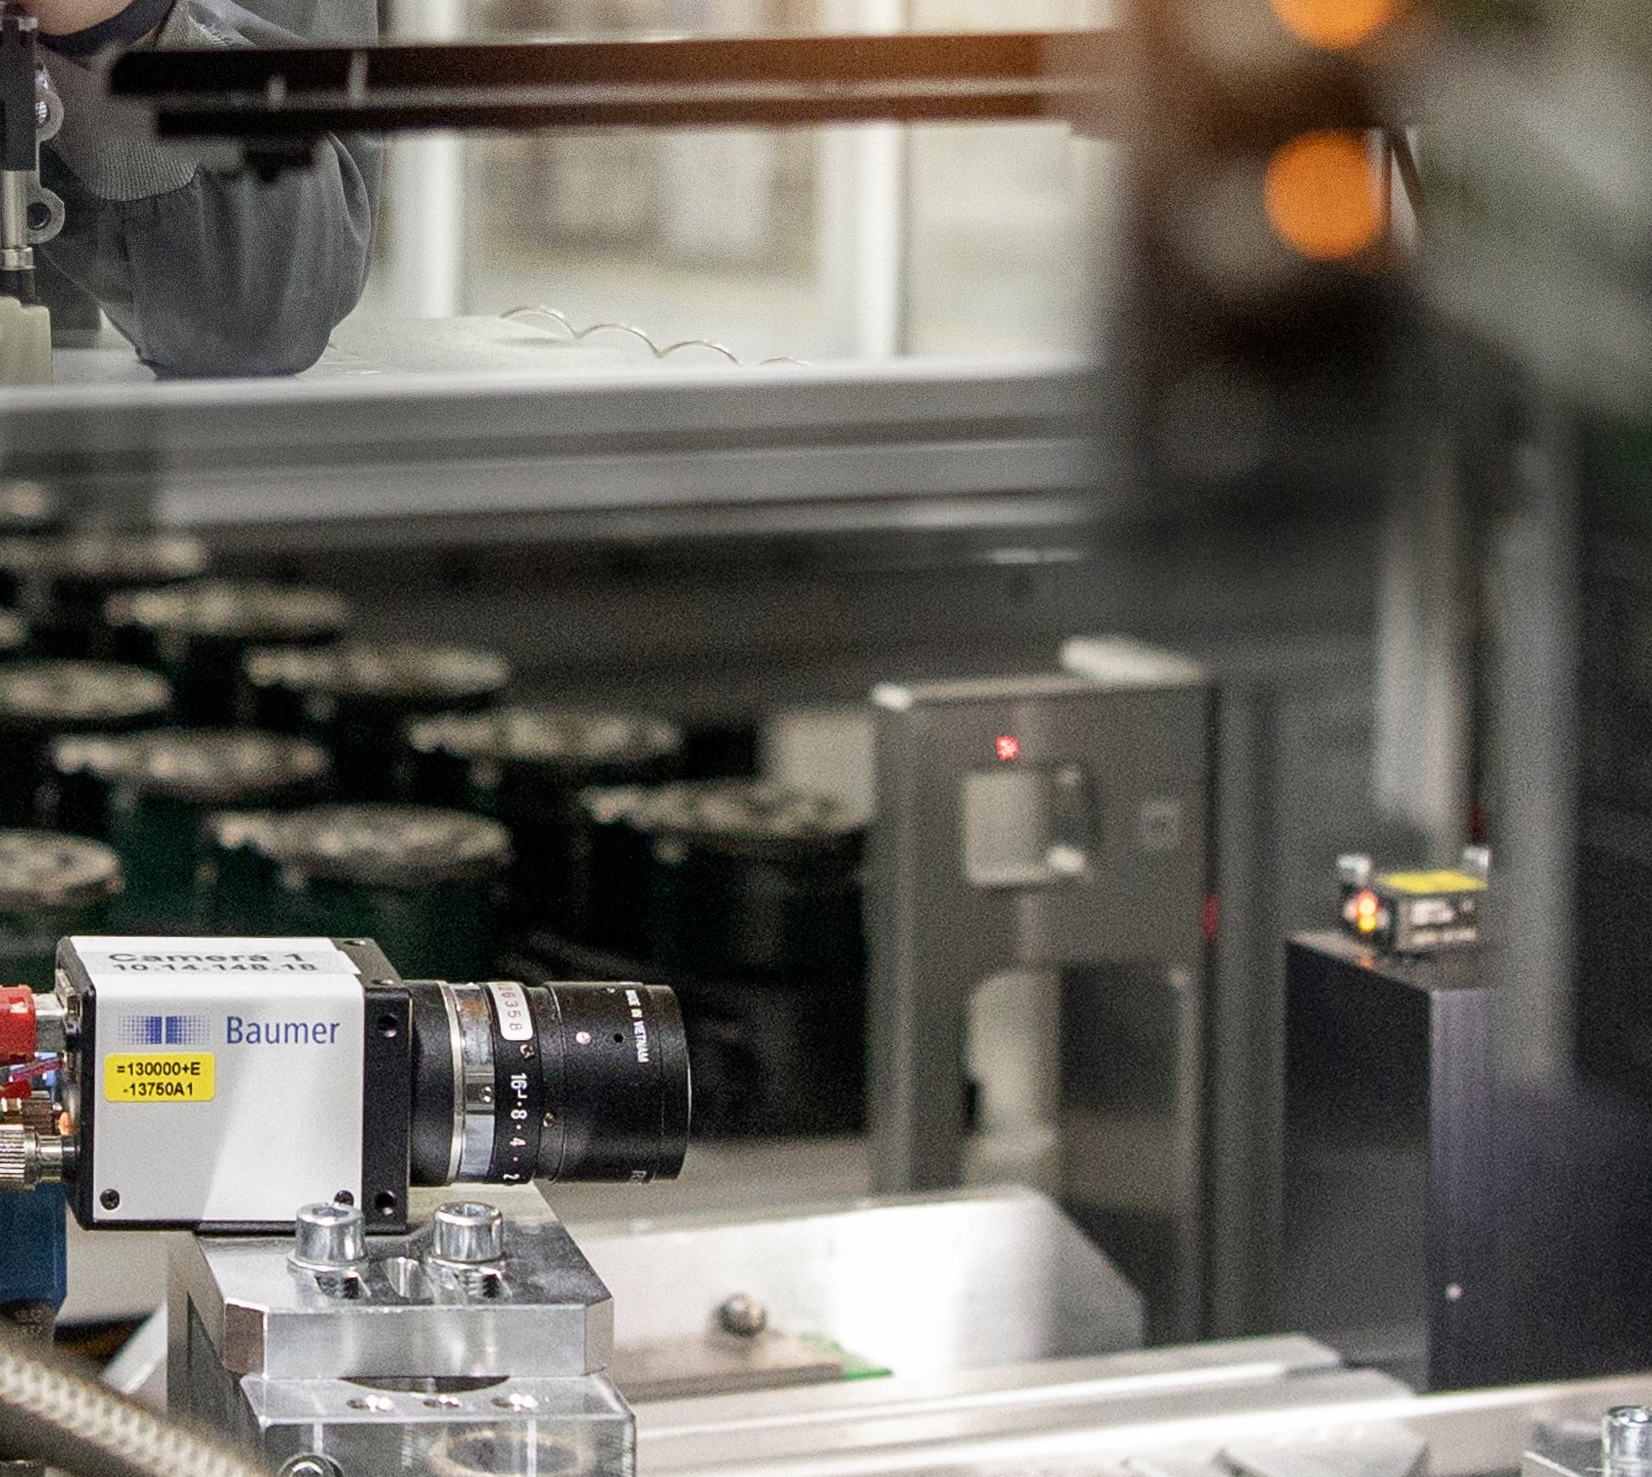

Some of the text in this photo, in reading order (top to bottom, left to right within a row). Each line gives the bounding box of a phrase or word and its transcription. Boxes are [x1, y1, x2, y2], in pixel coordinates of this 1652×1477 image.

[109, 952, 305, 962] Camera 1
[226, 1015, 341, 1044] Baumer
[633, 1020, 649, 1062] VIETNAM
[117, 1062, 201, 1076] =130000+E
[123, 1083, 194, 1096] -13750A1
[510, 1109, 527, 1120] 8
[509, 1137, 526, 1146] 4
